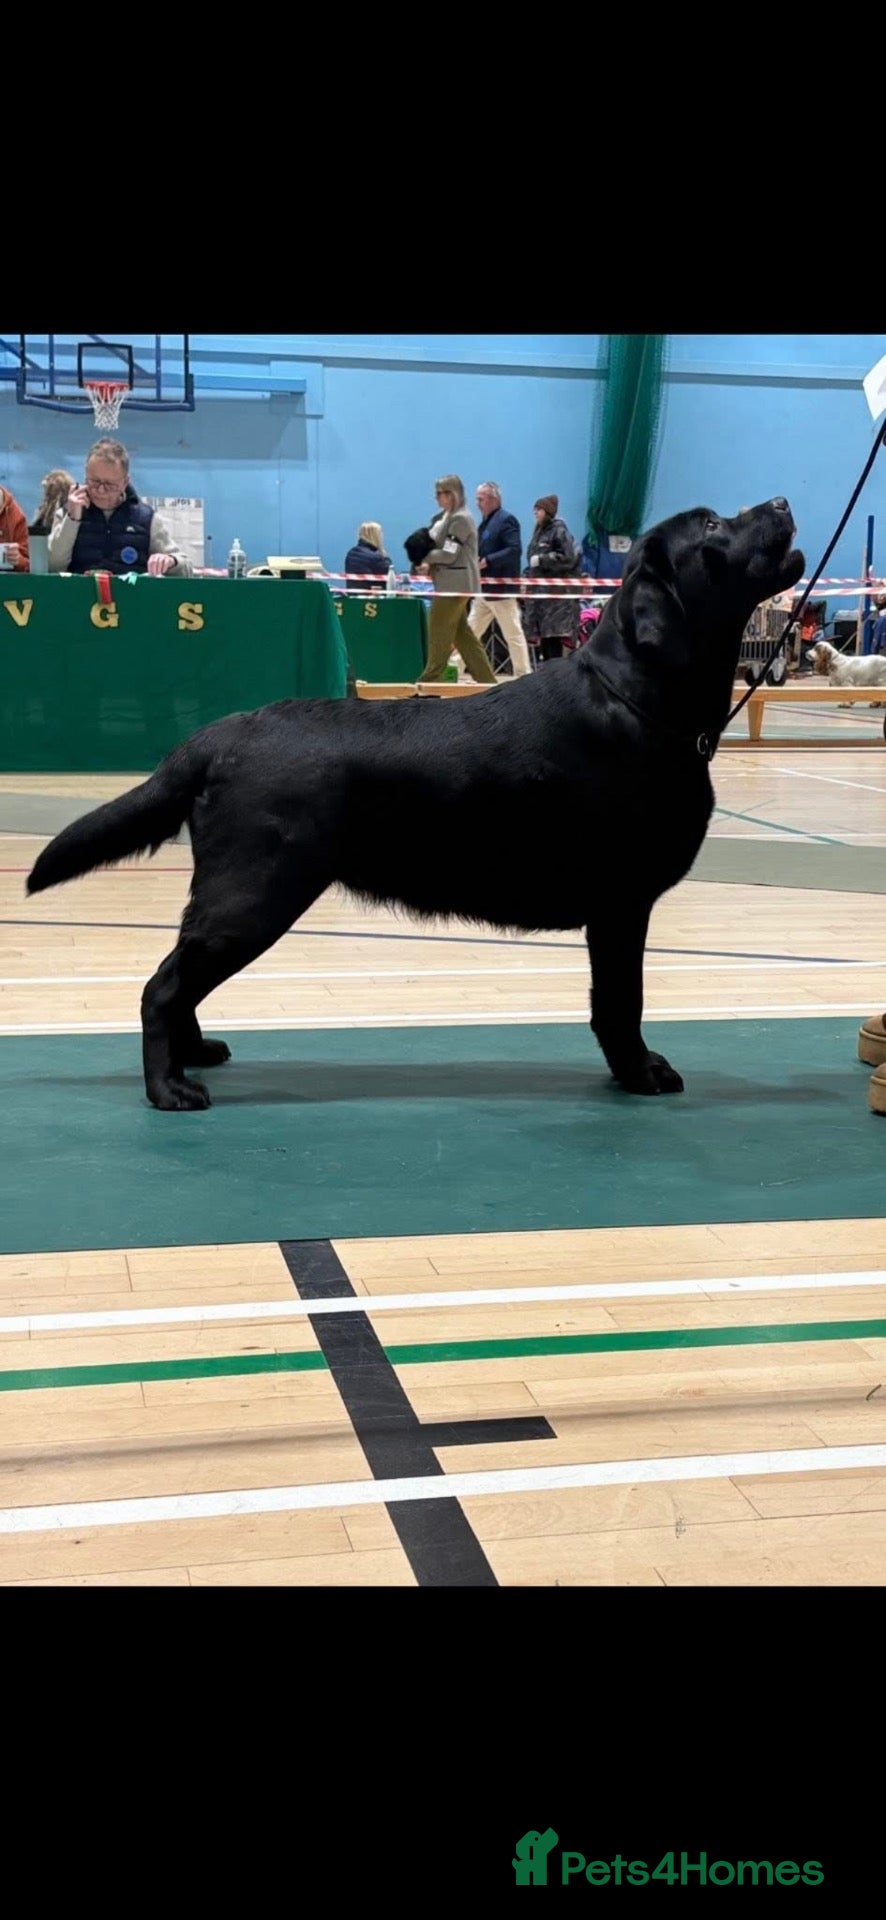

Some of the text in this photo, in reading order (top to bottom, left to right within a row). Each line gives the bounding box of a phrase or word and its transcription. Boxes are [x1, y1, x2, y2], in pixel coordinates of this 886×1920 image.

[4, 599, 204, 630] V G S
[364, 602, 377, 617] S
